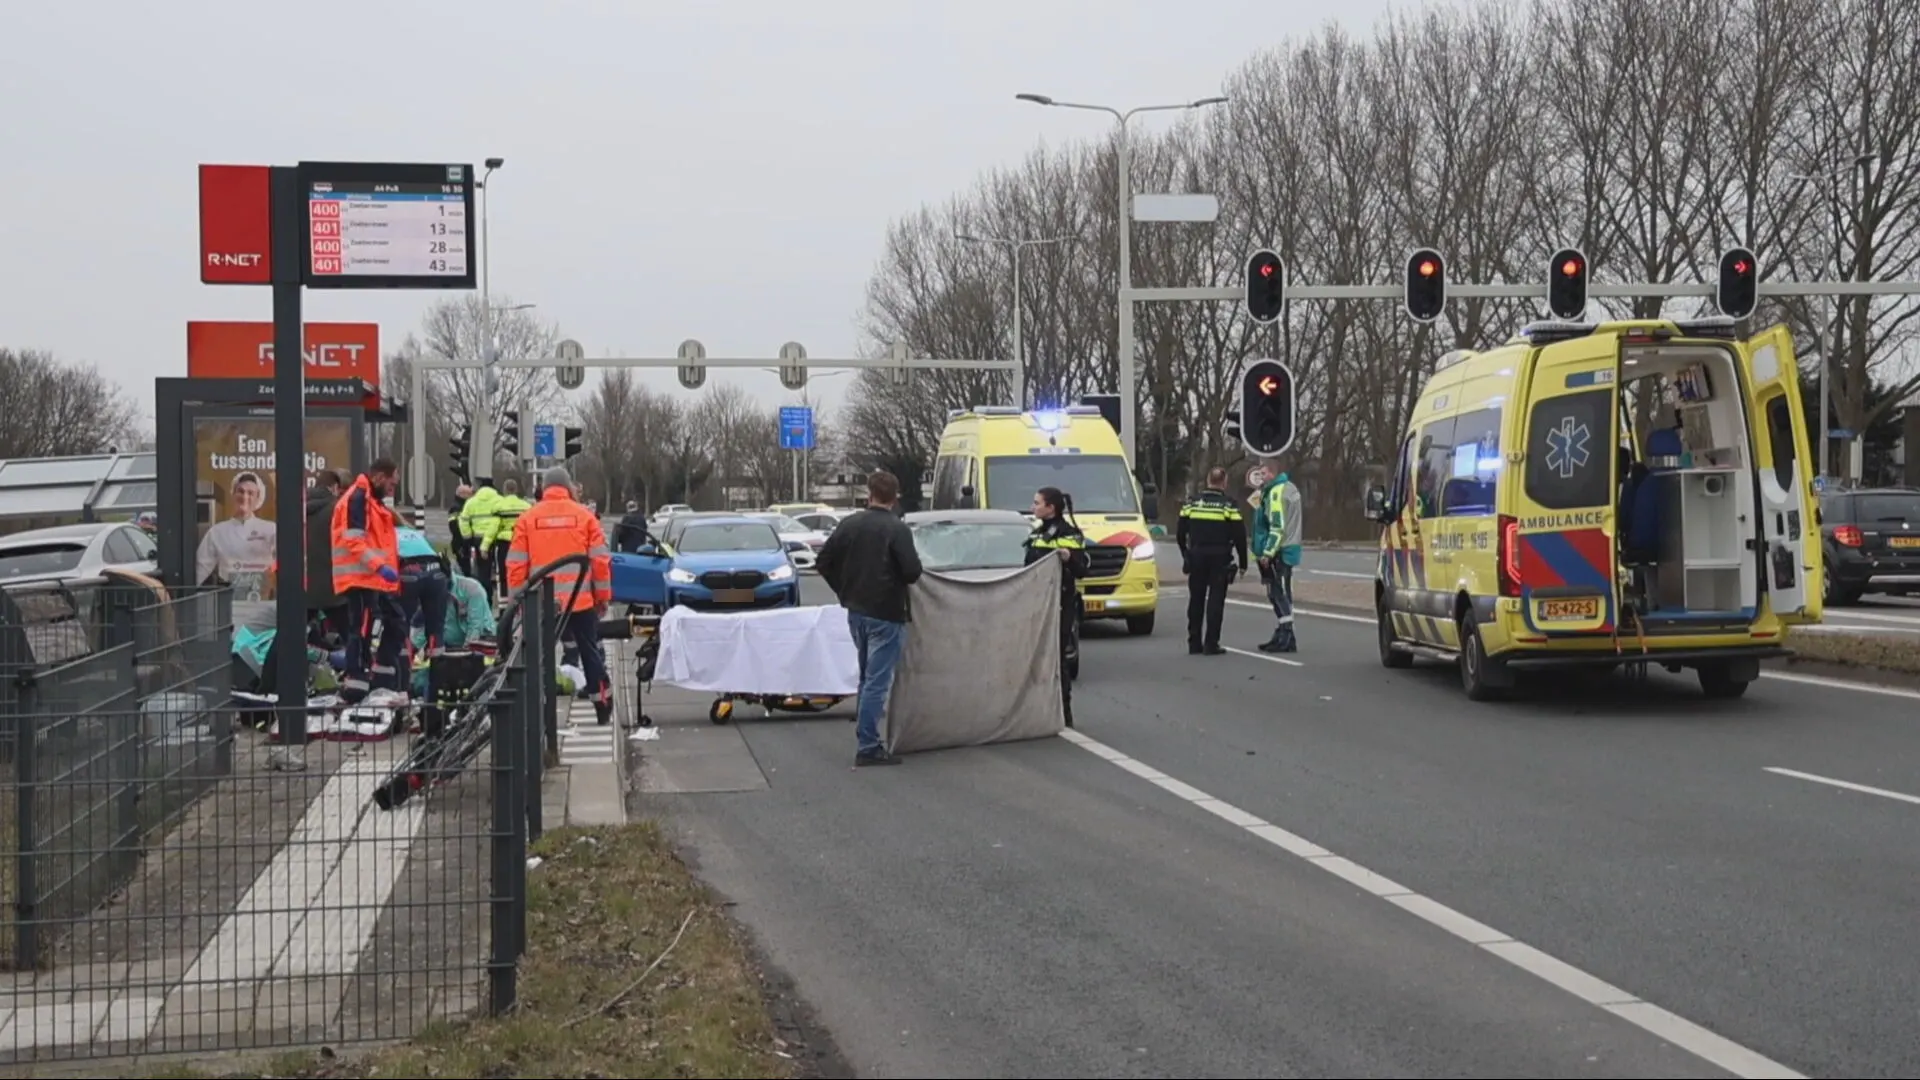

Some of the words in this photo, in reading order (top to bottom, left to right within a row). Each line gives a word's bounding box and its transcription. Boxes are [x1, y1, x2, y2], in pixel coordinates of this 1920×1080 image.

[313, 203, 338, 216] 400
[438, 205, 445, 216] 1
[314, 222, 339, 234] 401
[430, 223, 446, 235] 13
[314, 241, 339, 253] 400
[429, 241, 447, 253] 28
[314, 259, 339, 271] 401
[429, 260, 446, 271] 43
[238, 434, 267, 453] Een
[1519, 510, 1604, 530] AMBULANCE
